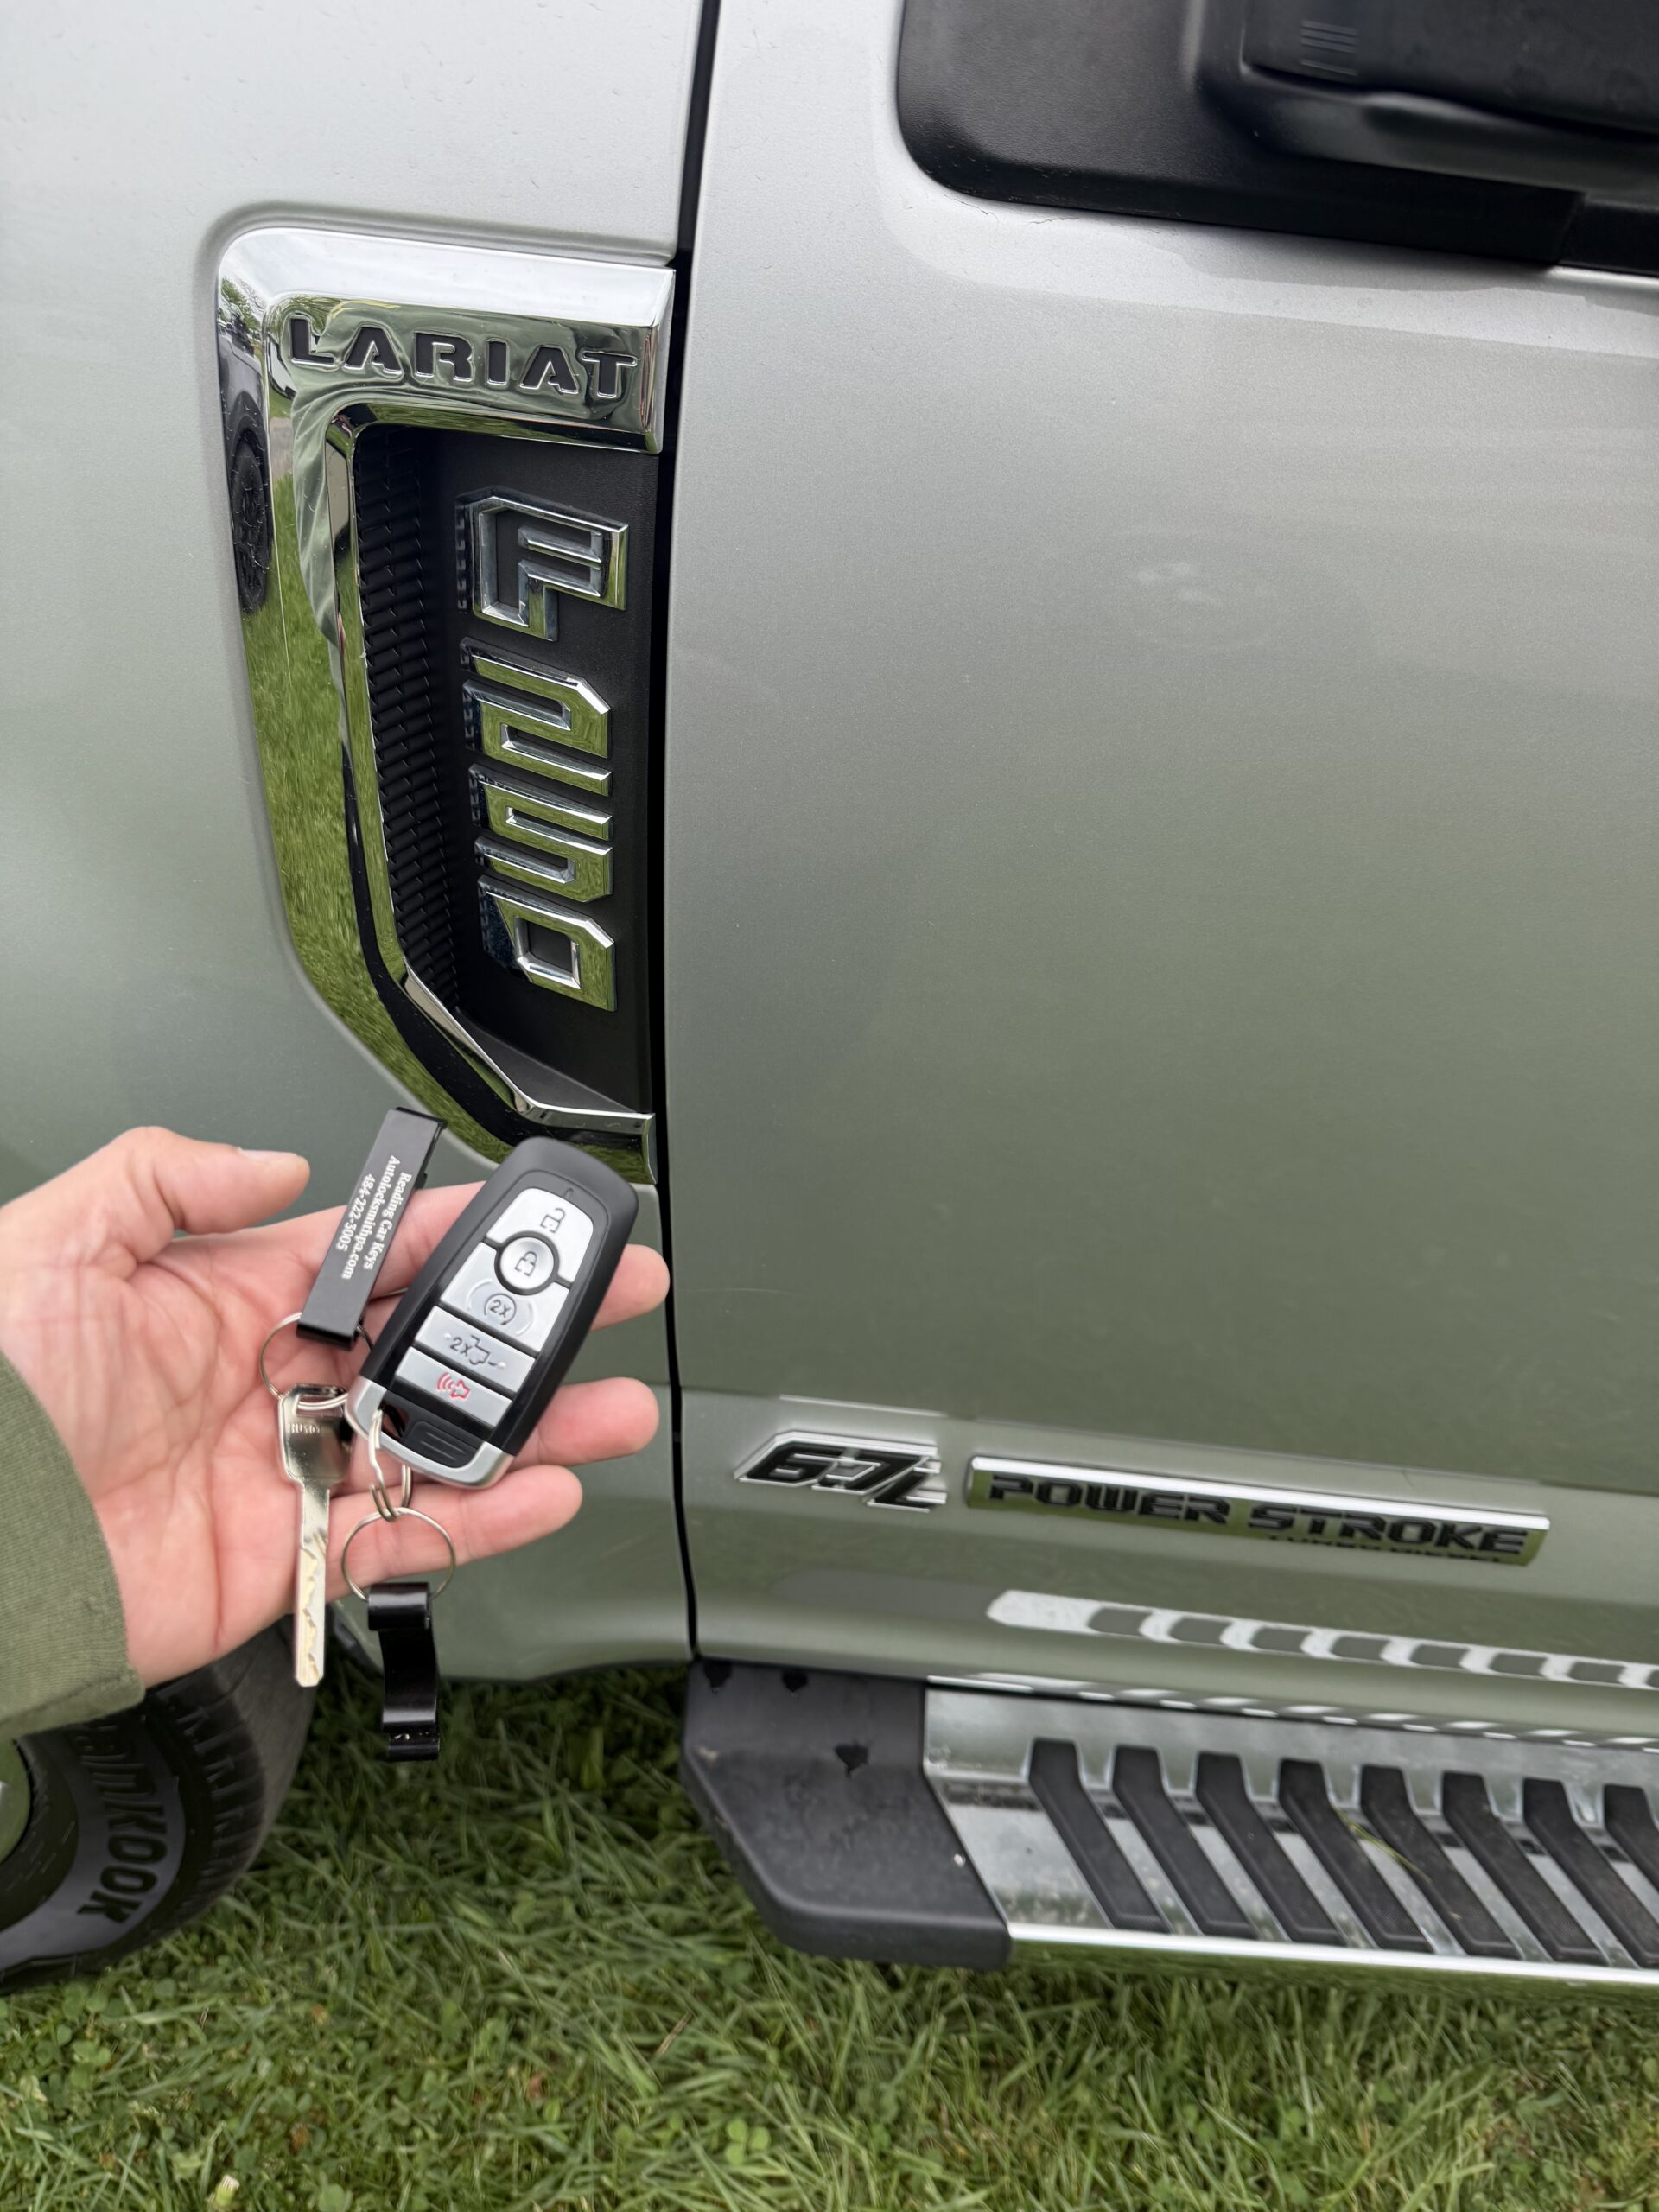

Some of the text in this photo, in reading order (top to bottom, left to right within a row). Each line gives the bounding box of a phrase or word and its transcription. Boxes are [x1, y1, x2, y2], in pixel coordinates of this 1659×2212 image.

[289, 316, 638, 398] LARIAT
[335, 1173, 376, 1251] 484-222-3005
[340, 1154, 401, 1280] Autolocksmithpa.com
[363, 1173, 412, 1270] Reading Car Keys
[989, 1474, 1230, 1525] POWER
[1249, 1504, 1528, 1554] STROKE
